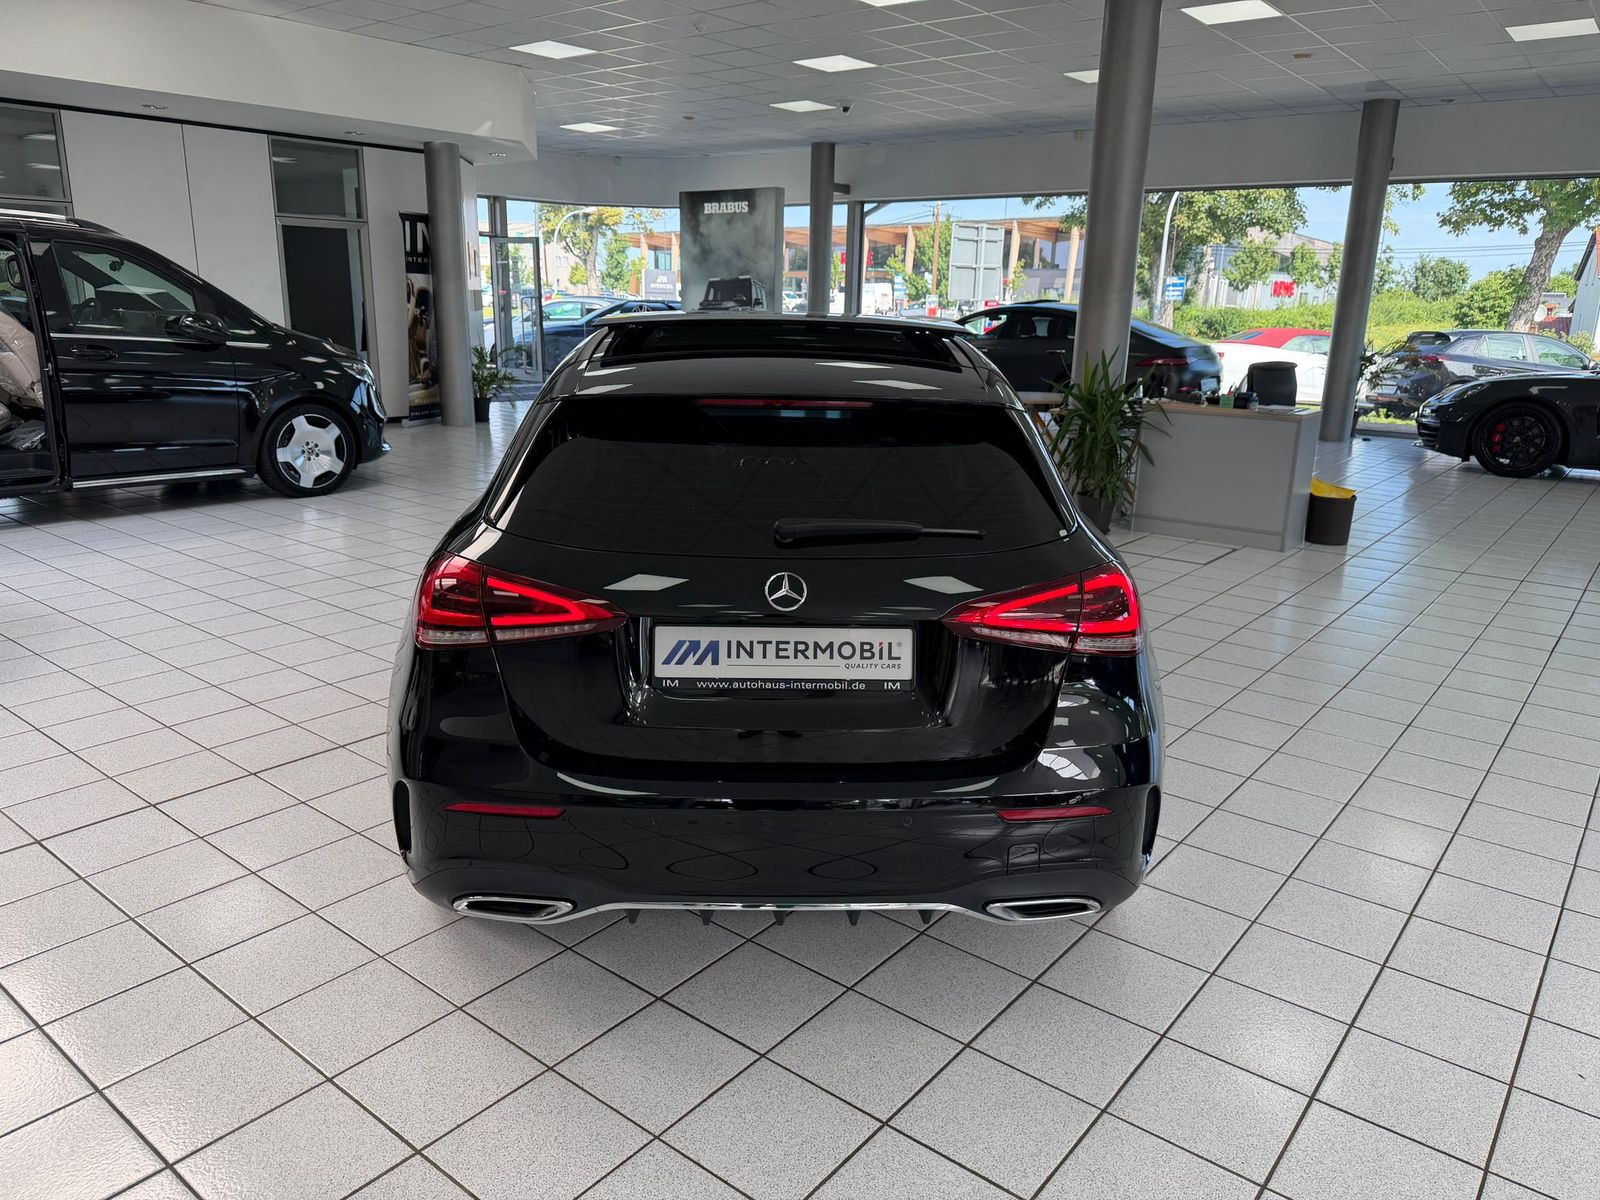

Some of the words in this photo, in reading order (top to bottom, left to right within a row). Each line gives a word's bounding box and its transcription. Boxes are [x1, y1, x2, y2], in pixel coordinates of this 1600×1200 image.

[704, 201, 749, 214] BRABUS
[662, 679, 679, 687] IM
[696, 680, 866, 690] www.autohaus-intermobil.de
[884, 681, 901, 689] IM
